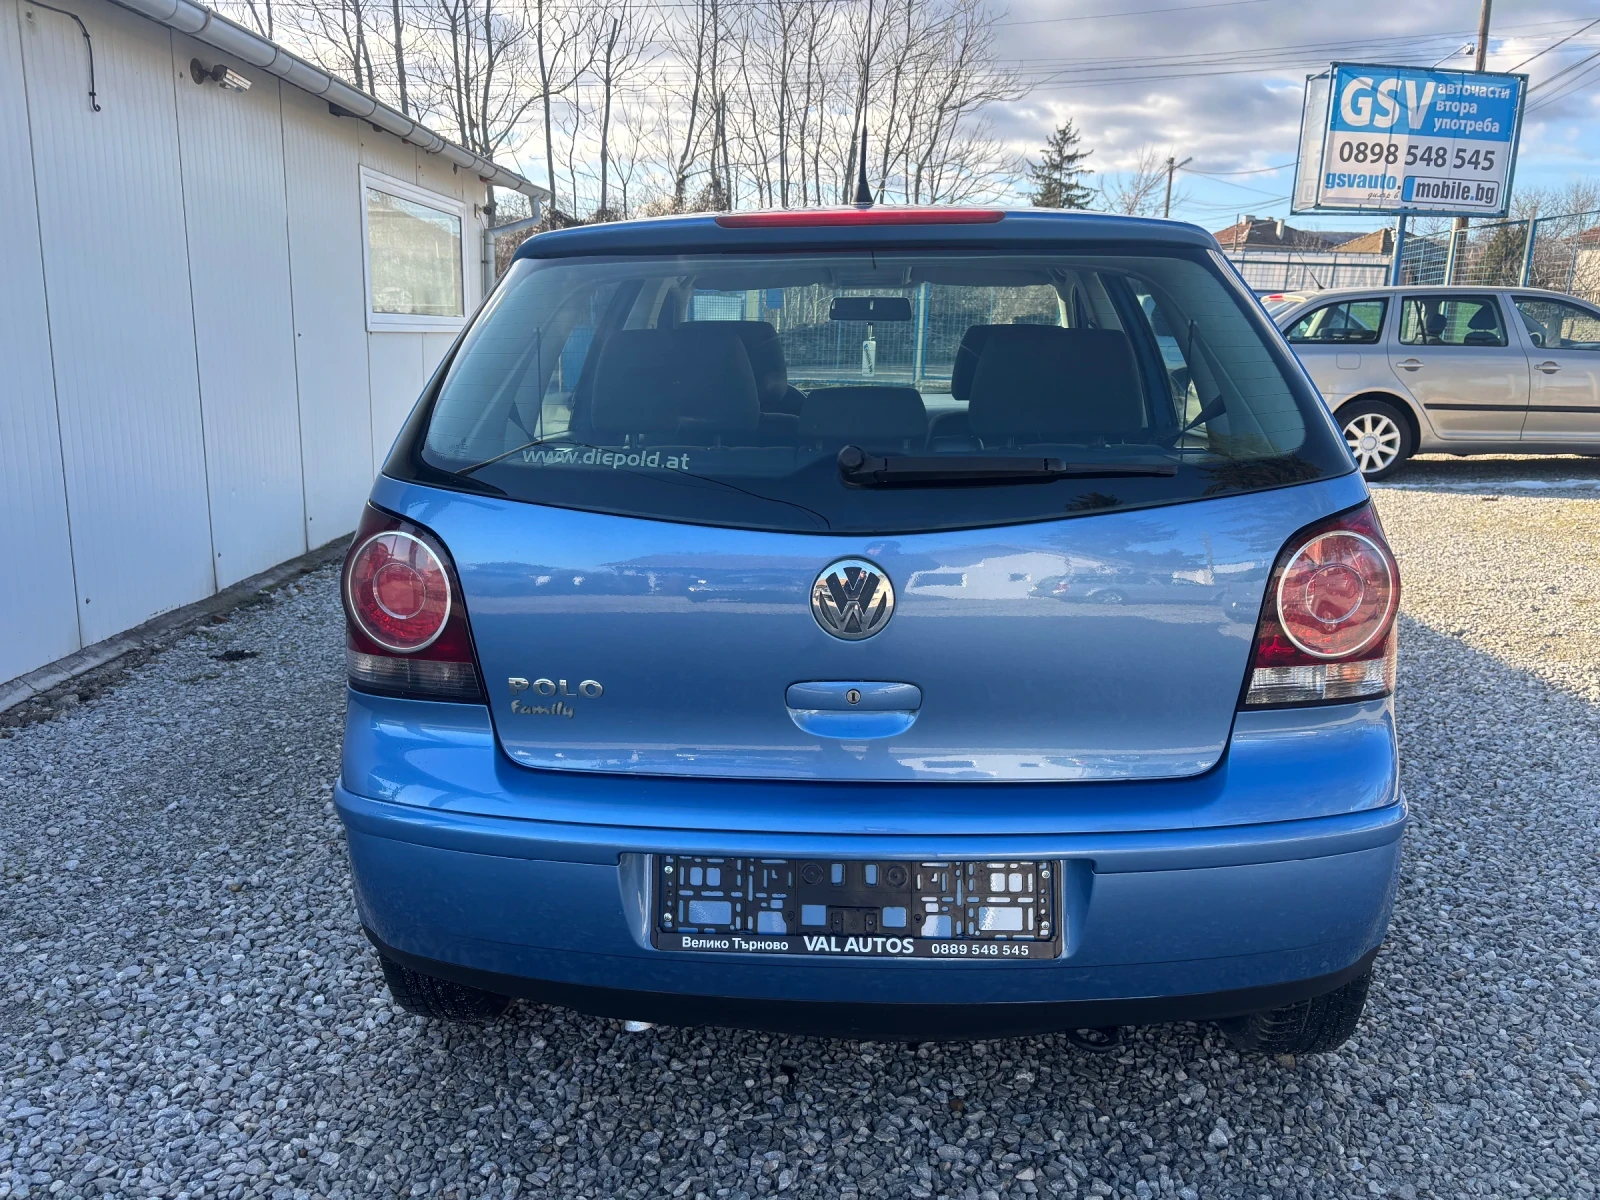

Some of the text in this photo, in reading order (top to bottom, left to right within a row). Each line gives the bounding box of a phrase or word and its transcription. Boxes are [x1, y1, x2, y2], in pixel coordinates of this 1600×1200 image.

[1438, 83, 1510, 99] авточасти
[1341, 77, 1436, 130] GSV
[1436, 100, 1477, 114] втора
[1433, 117, 1500, 134] употреба
[1339, 141, 1495, 171] 0898 548 545
[1415, 181, 1496, 204] mobile.bg
[522, 449, 690, 469] www.diepold.at
[508, 677, 604, 699] POLO
[510, 700, 575, 719] Family
[682, 936, 789, 951] Велико Търново
[803, 936, 914, 954] VAL AUTOS
[931, 943, 1029, 956] 0889 548 545
